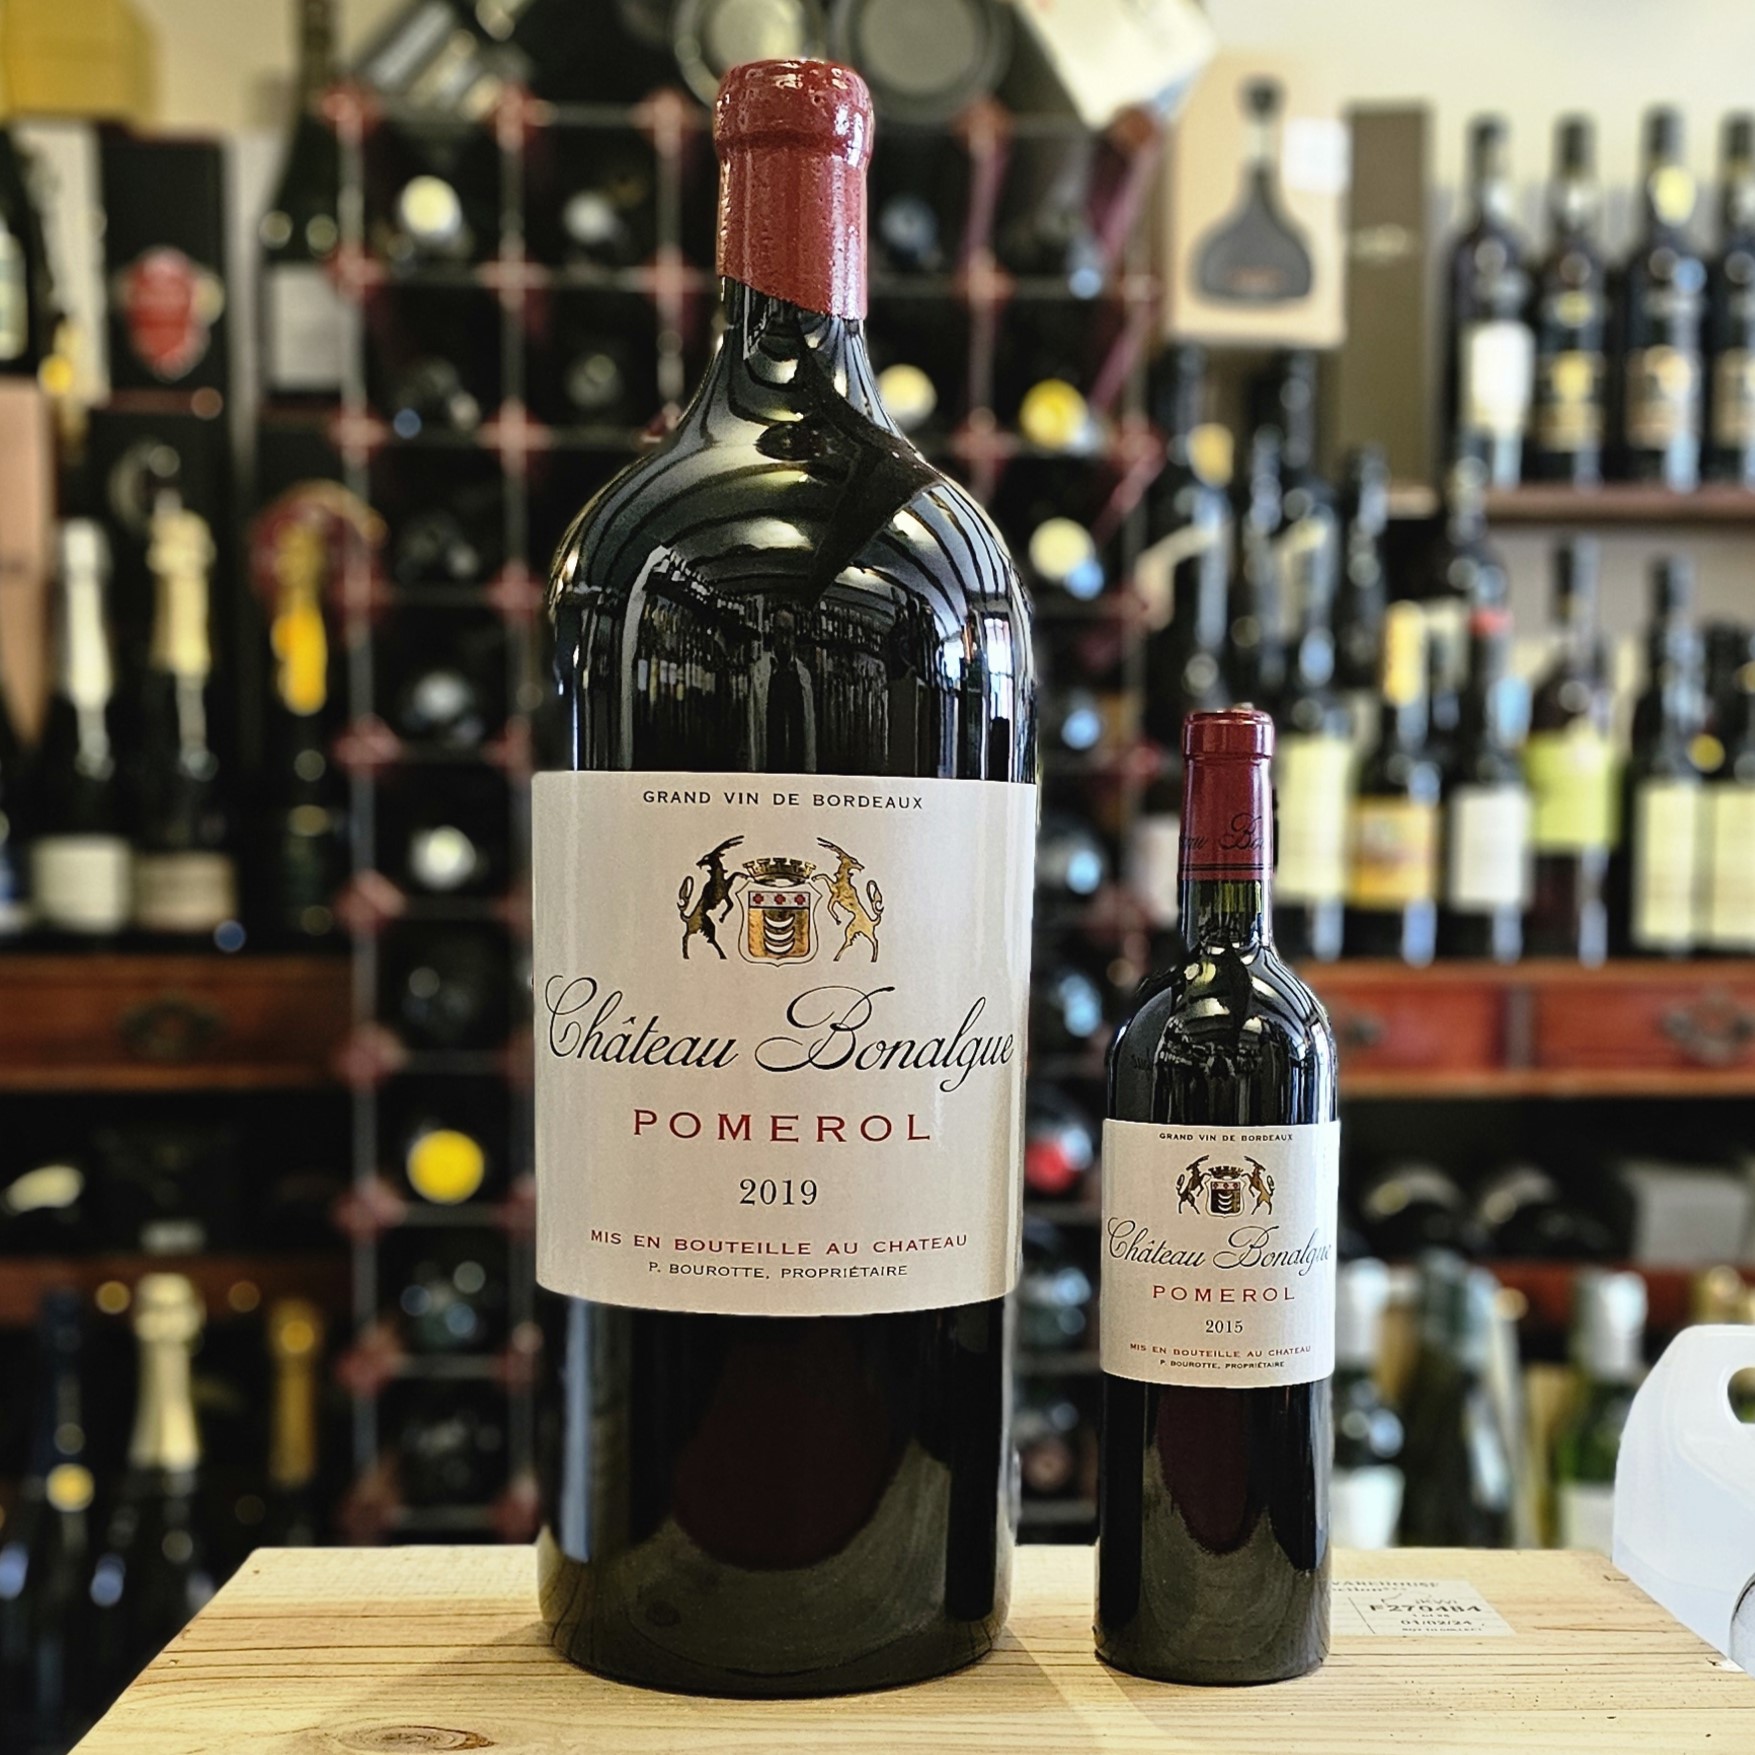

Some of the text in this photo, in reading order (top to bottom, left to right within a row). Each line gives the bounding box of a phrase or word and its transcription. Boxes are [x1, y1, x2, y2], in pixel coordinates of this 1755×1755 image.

[642, 789, 924, 811] GRAND VIN DE BORDEAUX
[543, 973, 1015, 1093] Château Bonalgue
[632, 1107, 931, 1144] POMEROL
[1158, 1131, 1294, 1143] GRAND VIN DE BORDEAUX
[737, 1176, 820, 1208] 2019
[589, 1228, 969, 1257] MIS EN BOUTEILLE AU CHATEAU
[1107, 1216, 1332, 1277] Château Bonalgue
[647, 1260, 910, 1281] P. BOUROTTE, PROPRIÉTAIRE
[1151, 1283, 1296, 1304] POMEROL
[1204, 1318, 1244, 1335] 2015
[1129, 1342, 1312, 1359] MIS EN BOUTEILLE AU CHATEAU
[1158, 1358, 1168, 1367] P.
[1169, 1360, 1221, 1370] BOUROTTE,
